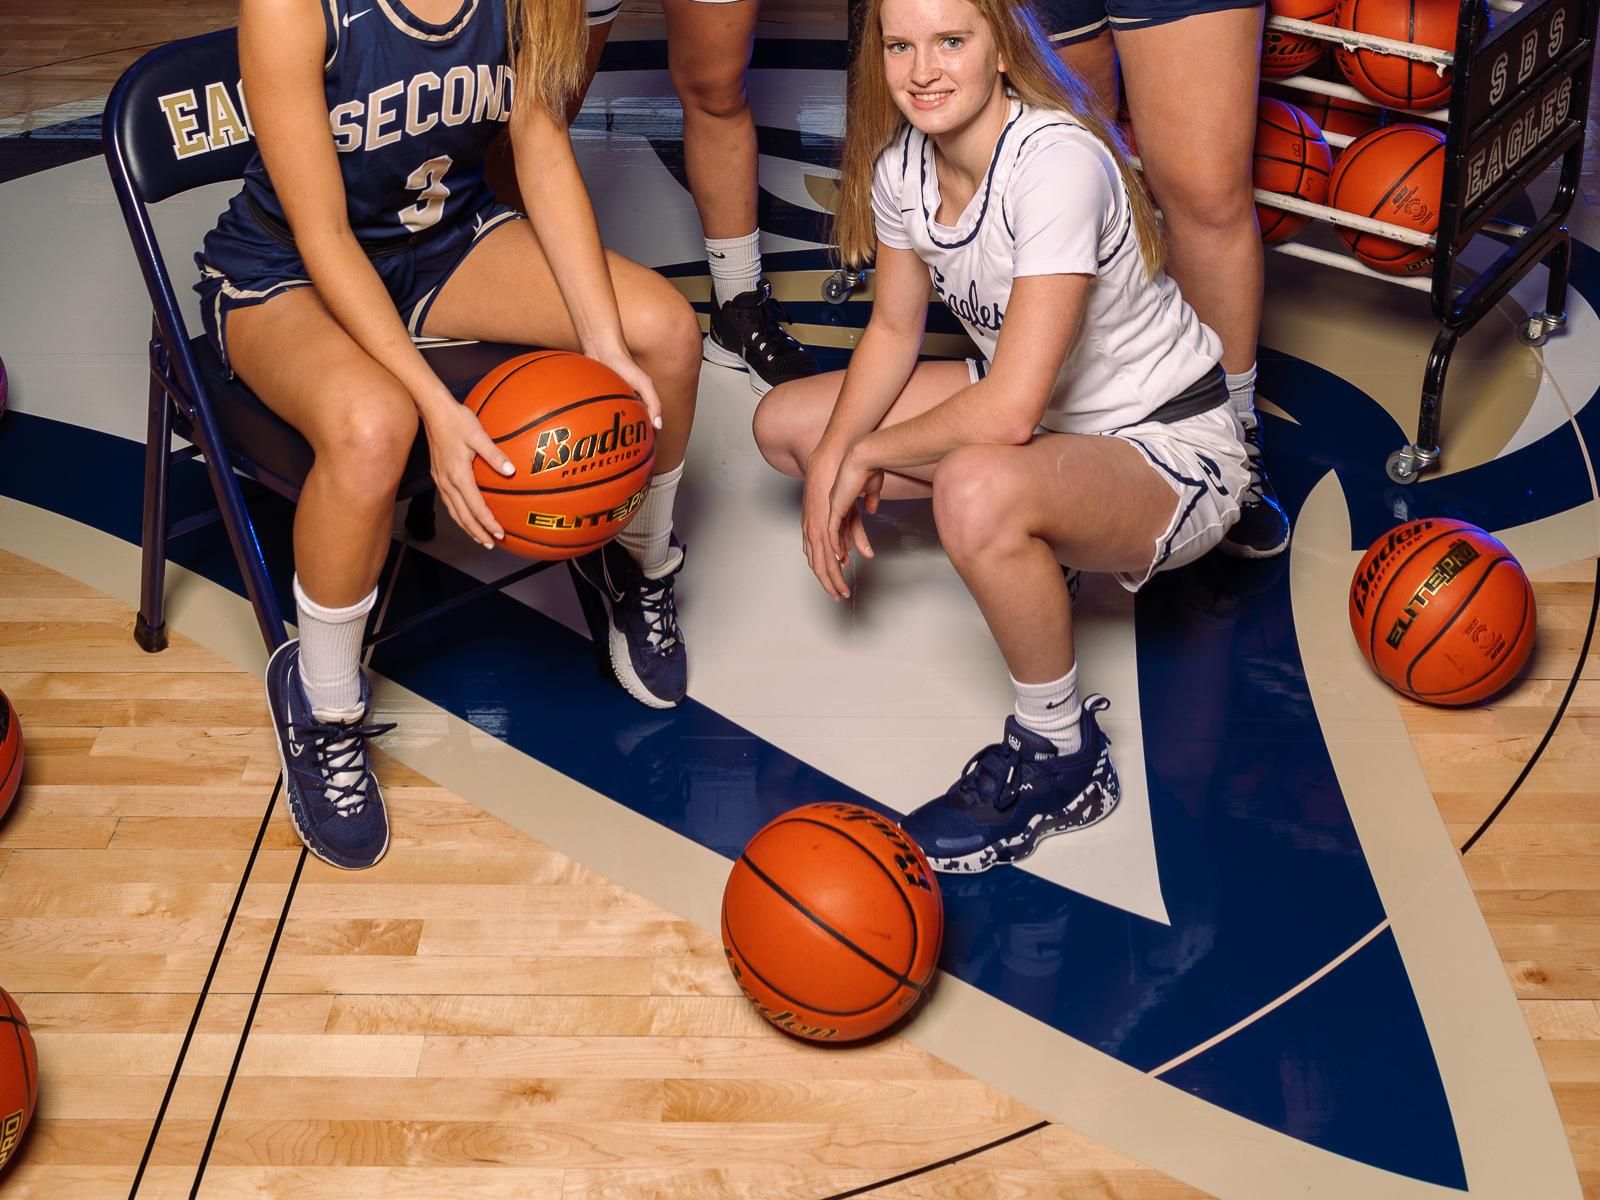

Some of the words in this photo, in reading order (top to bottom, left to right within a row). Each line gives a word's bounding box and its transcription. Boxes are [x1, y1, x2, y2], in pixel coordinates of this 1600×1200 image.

[1463, 76, 1573, 209] EAGLES
[398, 154, 453, 233] 3
[530, 411, 647, 477] Baden
[561, 448, 642, 479] PERFECTION
[1353, 520, 1434, 619] Baden
